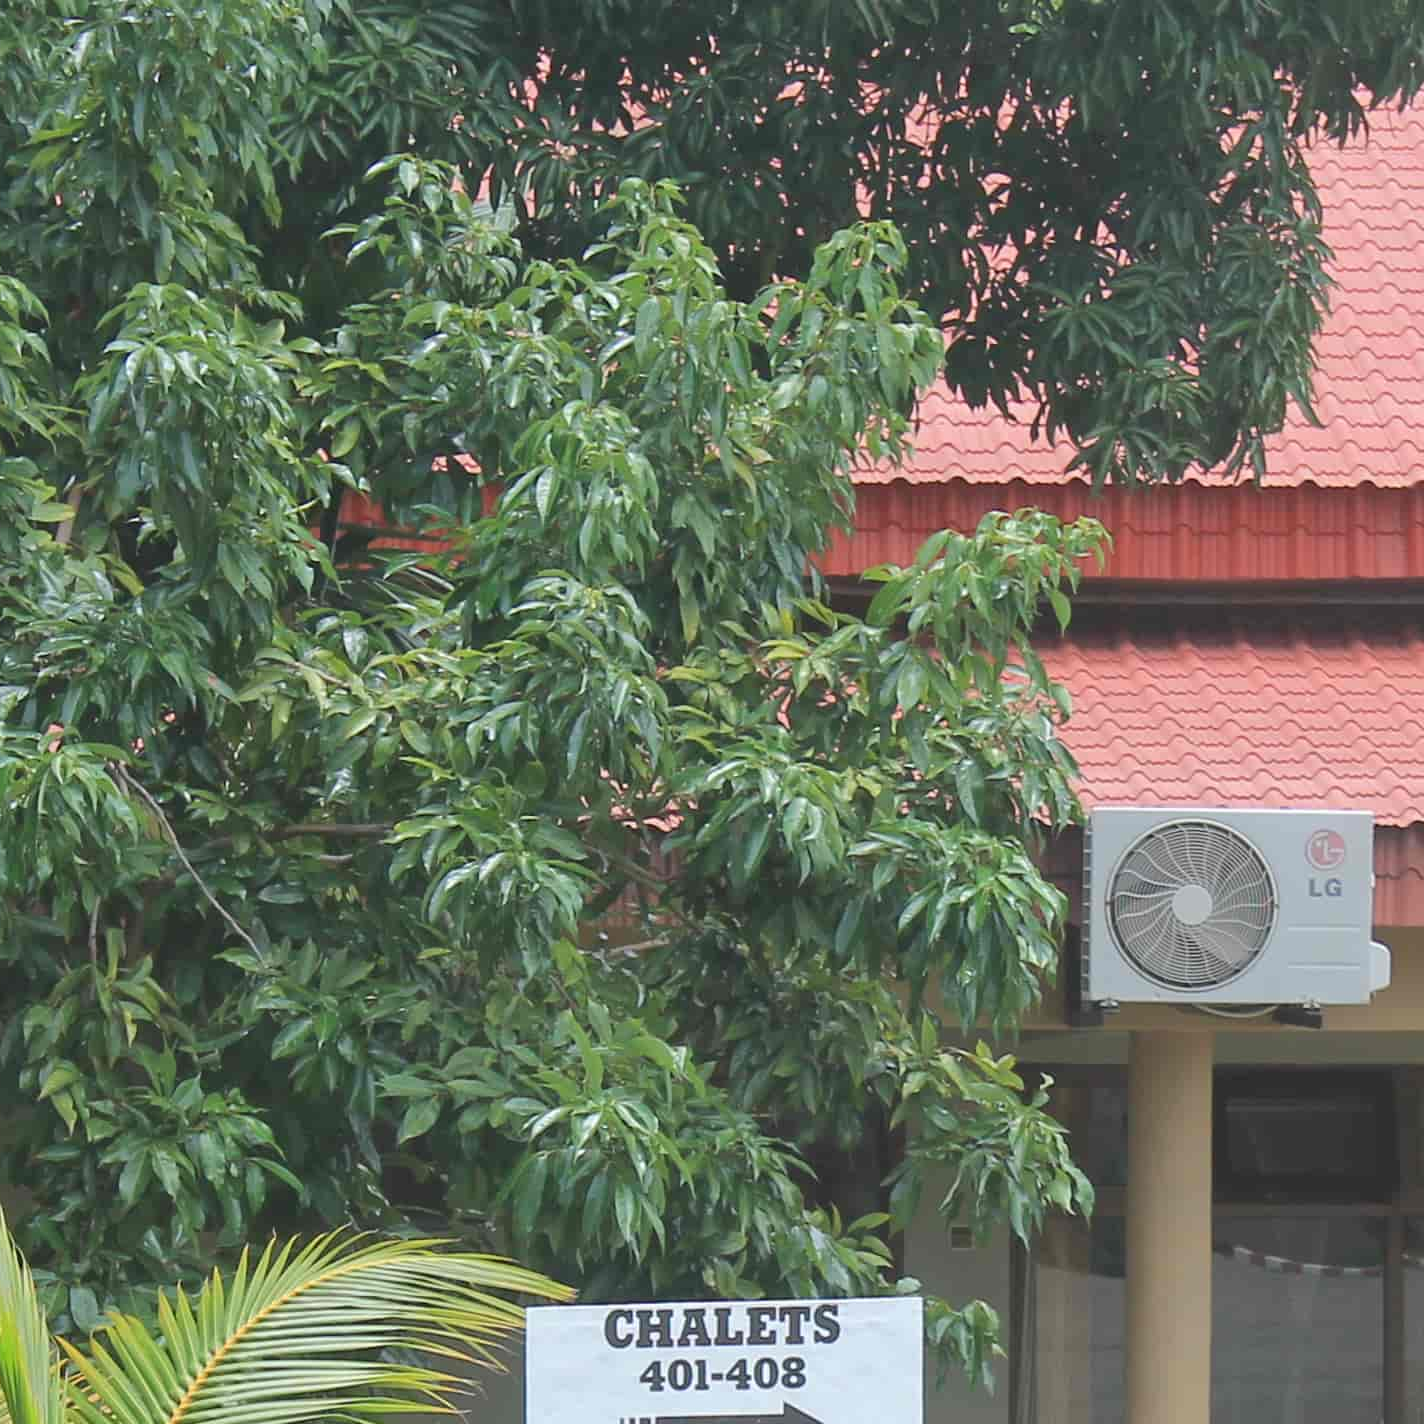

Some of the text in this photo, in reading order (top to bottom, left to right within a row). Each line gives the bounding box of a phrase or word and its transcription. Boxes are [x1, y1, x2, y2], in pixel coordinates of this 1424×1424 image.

[1309, 878, 1343, 897] LG
[604, 1304, 841, 1349] CHALETS
[639, 1357, 807, 1392] 401-408
